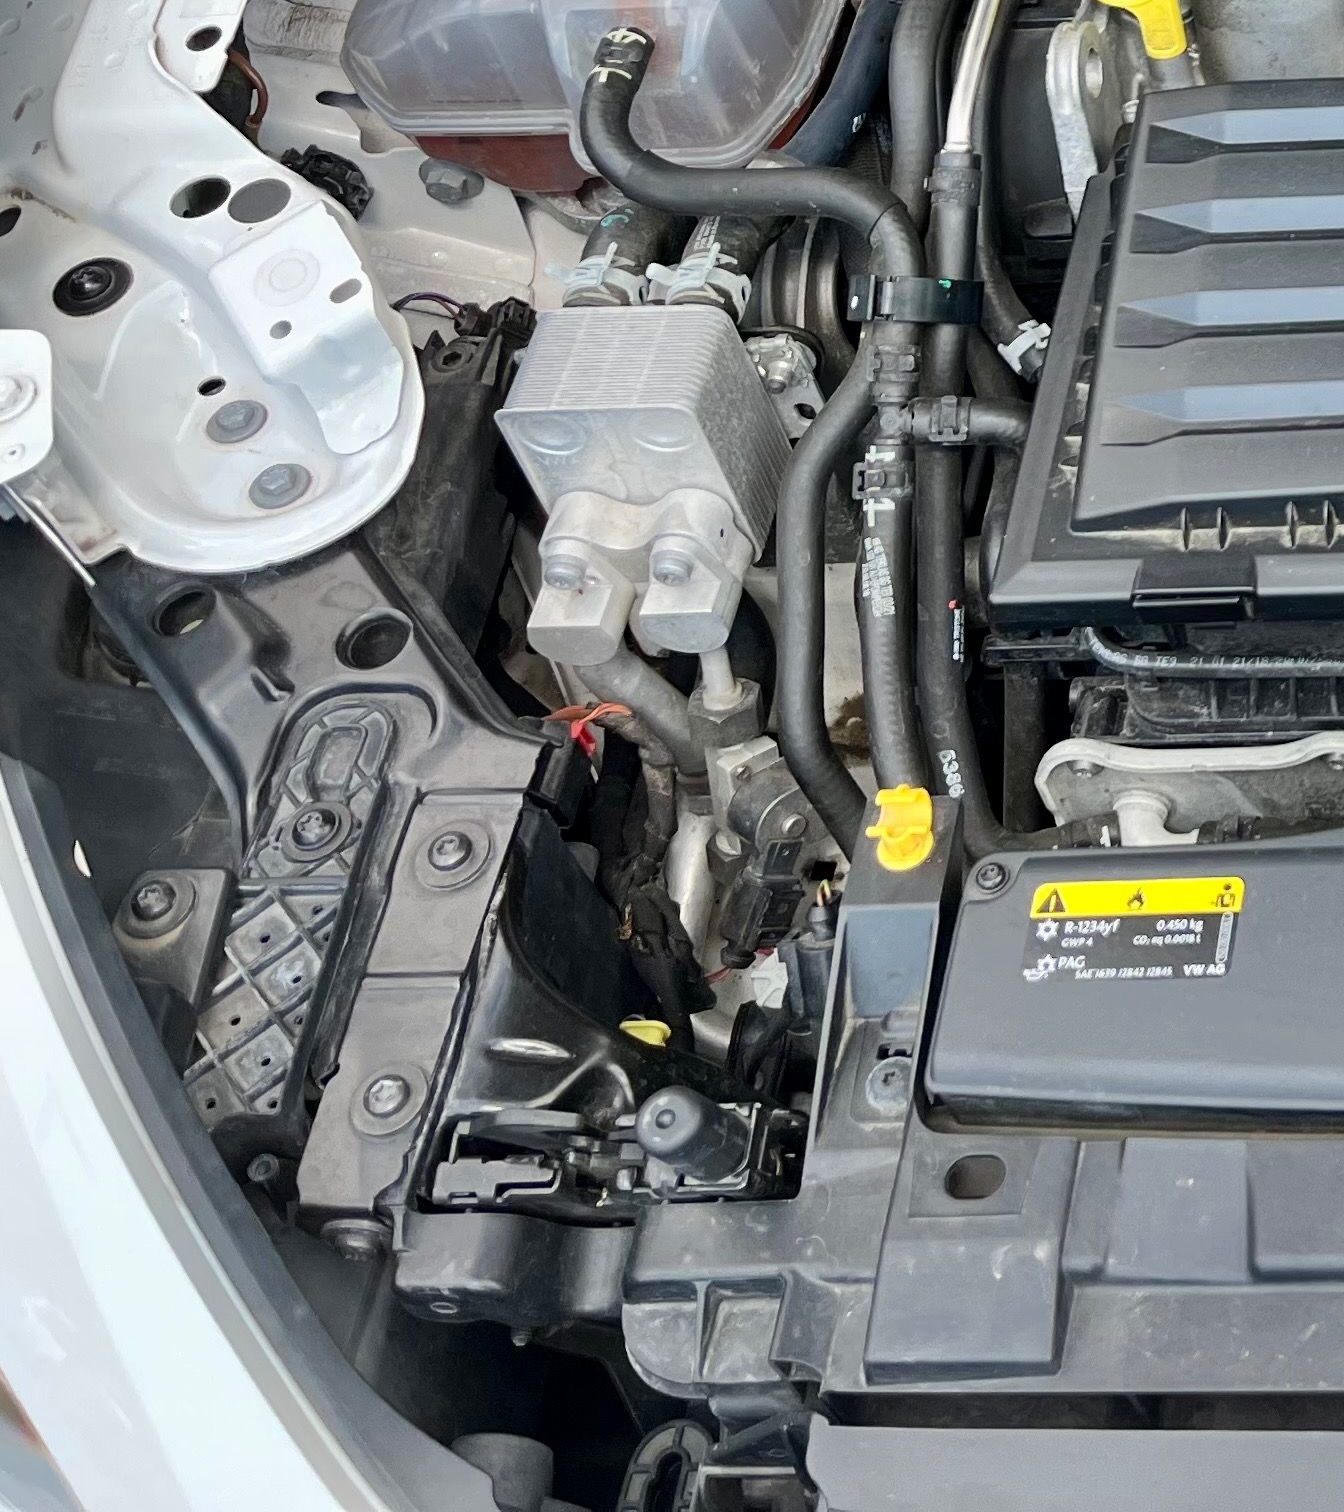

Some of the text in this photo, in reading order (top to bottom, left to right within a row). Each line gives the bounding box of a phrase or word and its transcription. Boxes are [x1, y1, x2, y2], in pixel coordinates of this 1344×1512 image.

[1064, 917, 1204, 937] R-1234yf 0.450 kg
[1061, 936, 1086, 948] GWP
[1085, 936, 1094, 947] 4
[1057, 955, 1086, 968] PAG
[1074, 968, 1094, 980] SAE
[1183, 963, 1206, 977] VW
[1206, 963, 1226, 976] AG
